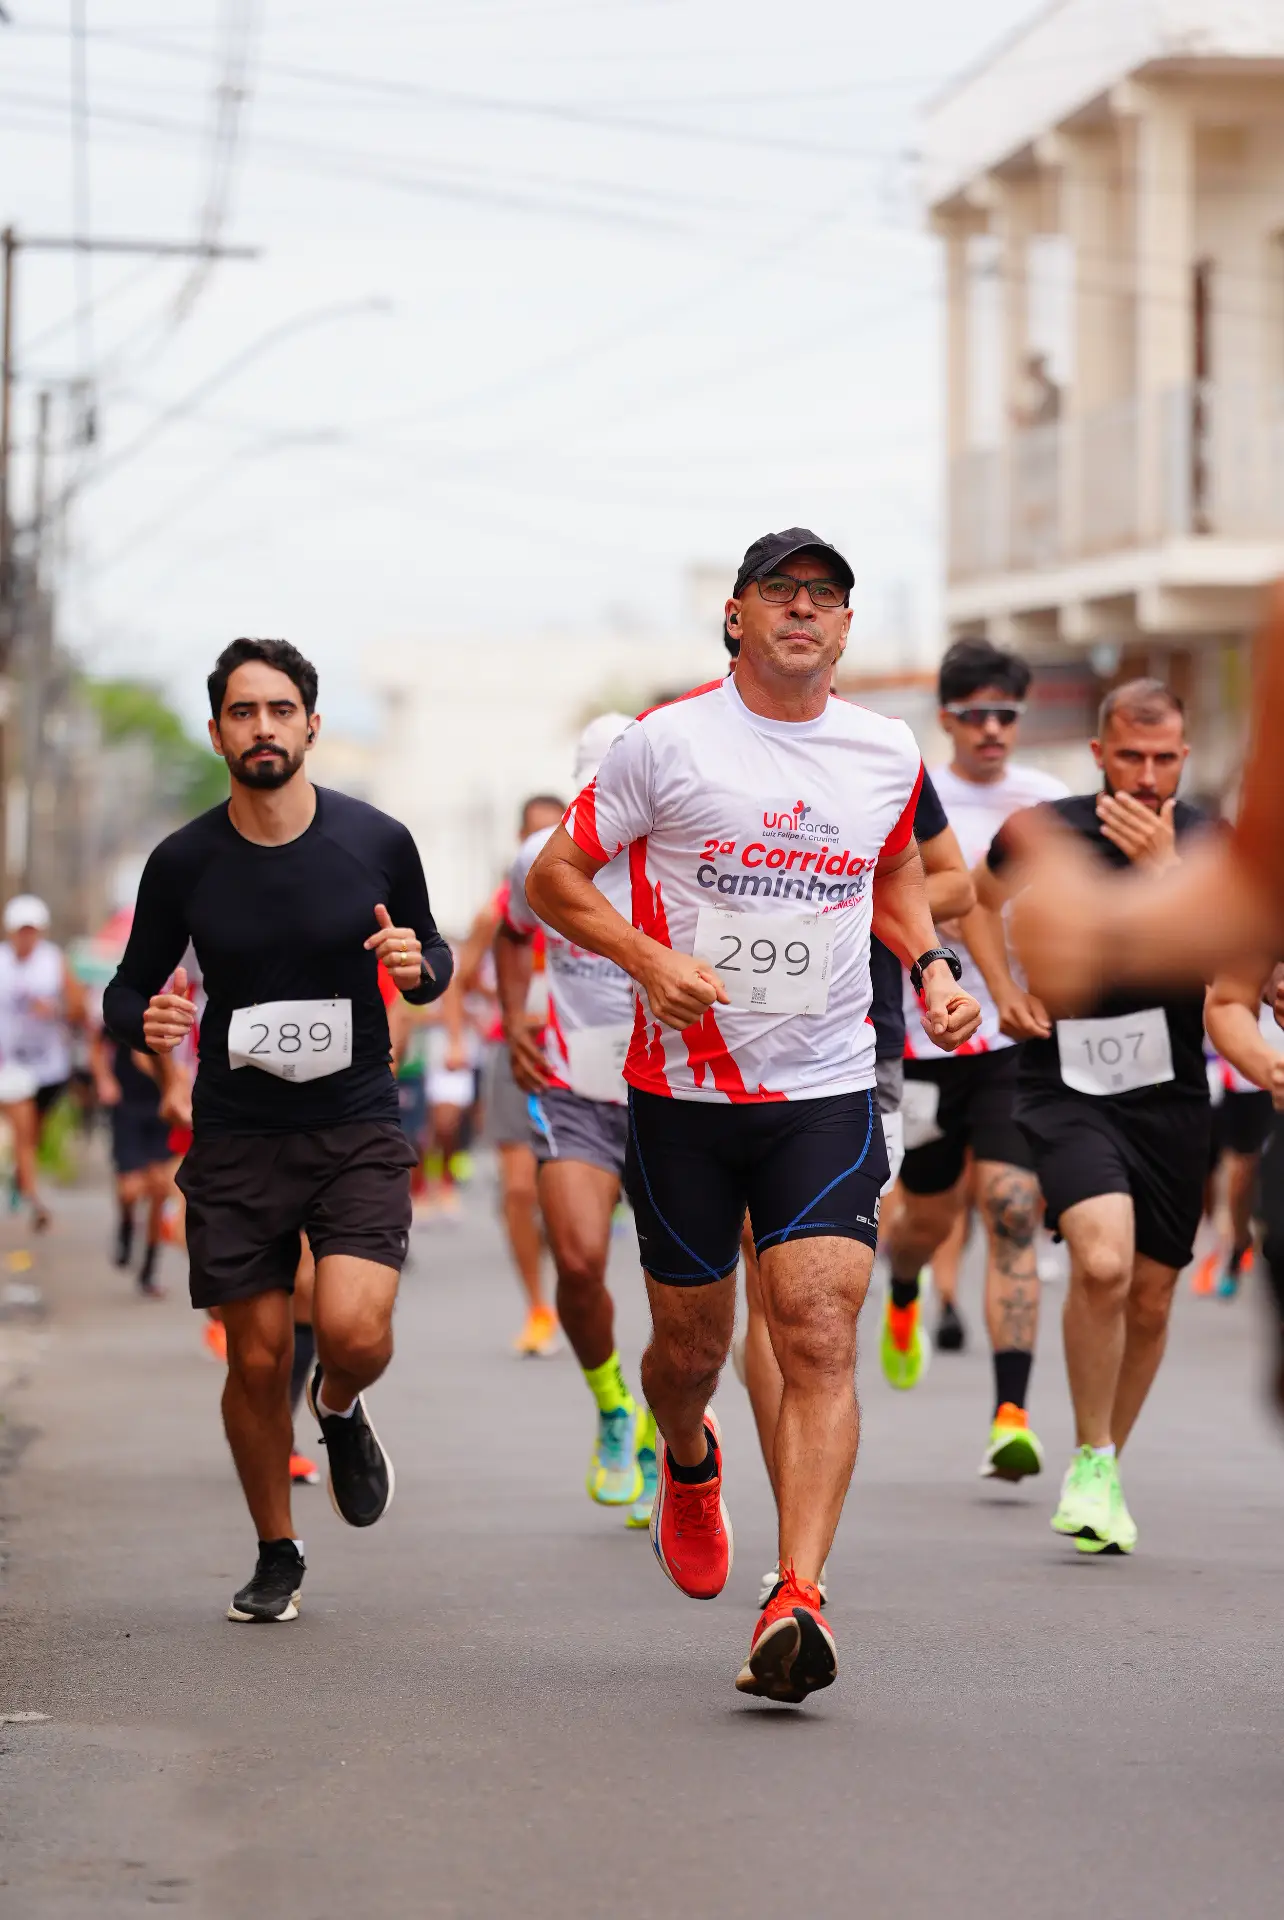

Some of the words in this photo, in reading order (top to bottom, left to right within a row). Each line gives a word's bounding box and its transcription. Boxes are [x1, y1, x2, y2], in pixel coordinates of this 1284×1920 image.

[762, 830, 777, 838] Luiz
[741, 842, 867, 877] Corrida
[714, 934, 811, 977] 299
[248, 1021, 332, 1055] 289
[1081, 1031, 1145, 1067] 107
